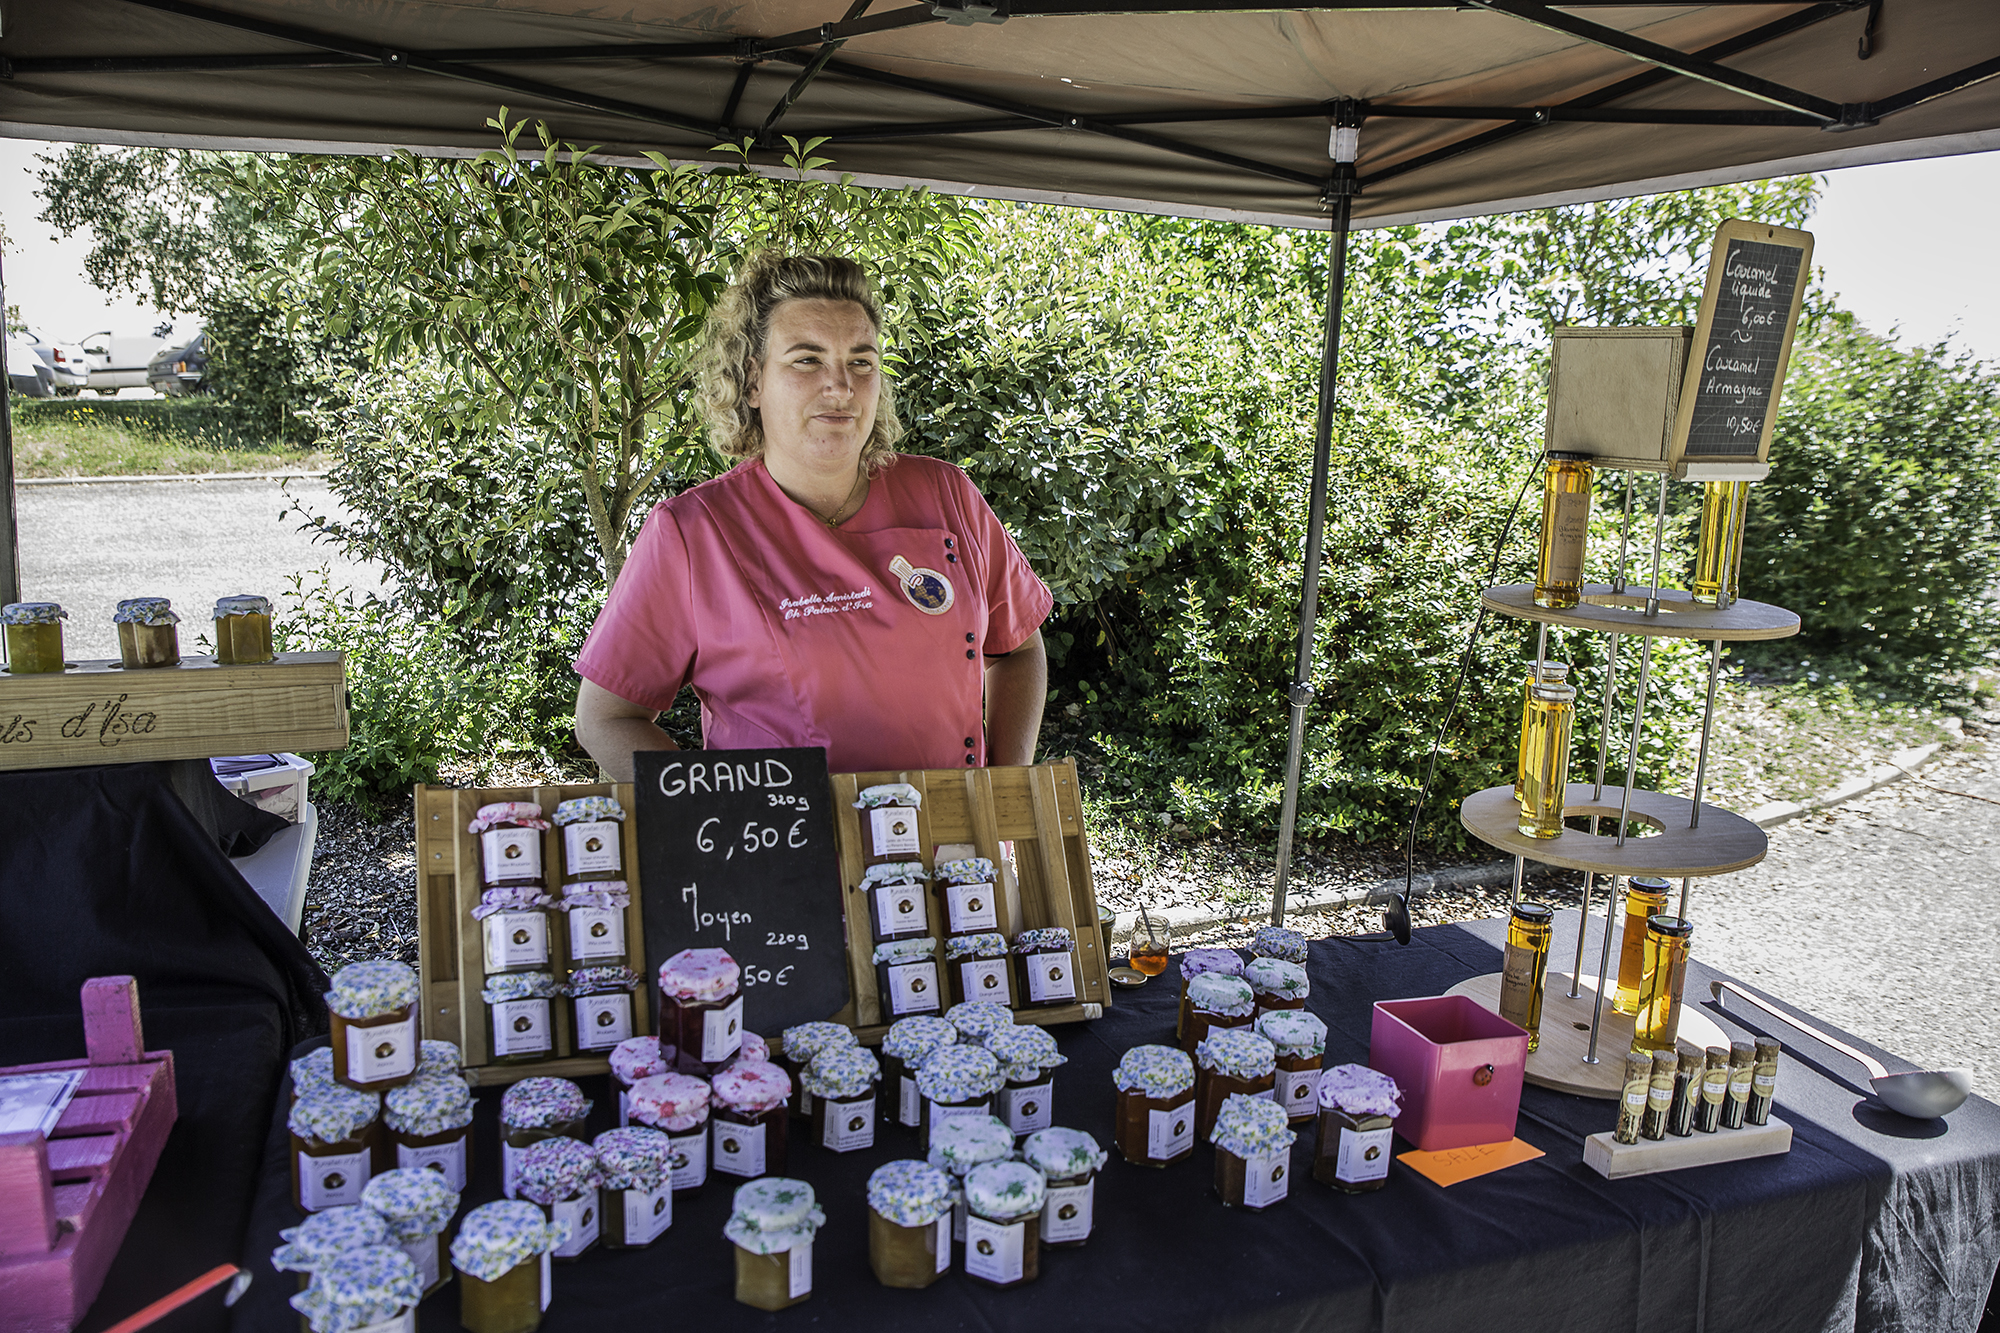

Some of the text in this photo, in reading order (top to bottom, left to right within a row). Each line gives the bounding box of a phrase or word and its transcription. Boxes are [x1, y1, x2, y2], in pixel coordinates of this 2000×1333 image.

[1725, 248, 1778, 286] Caramel
[1705, 344, 1760, 375] Caramel
[1705, 376, 1763, 404] Armagnac
[1725, 416, 1761, 437] 10,50€
[778, 585, 872, 611] Isabelle Amistadi
[803, 604, 840, 617] Palais
[841, 600, 874, 612] d'Isa
[659, 759, 793, 797] GRAND
[767, 793, 810, 811] 320g
[766, 932, 809, 950] 220g
[743, 965, 795, 987] 50€
